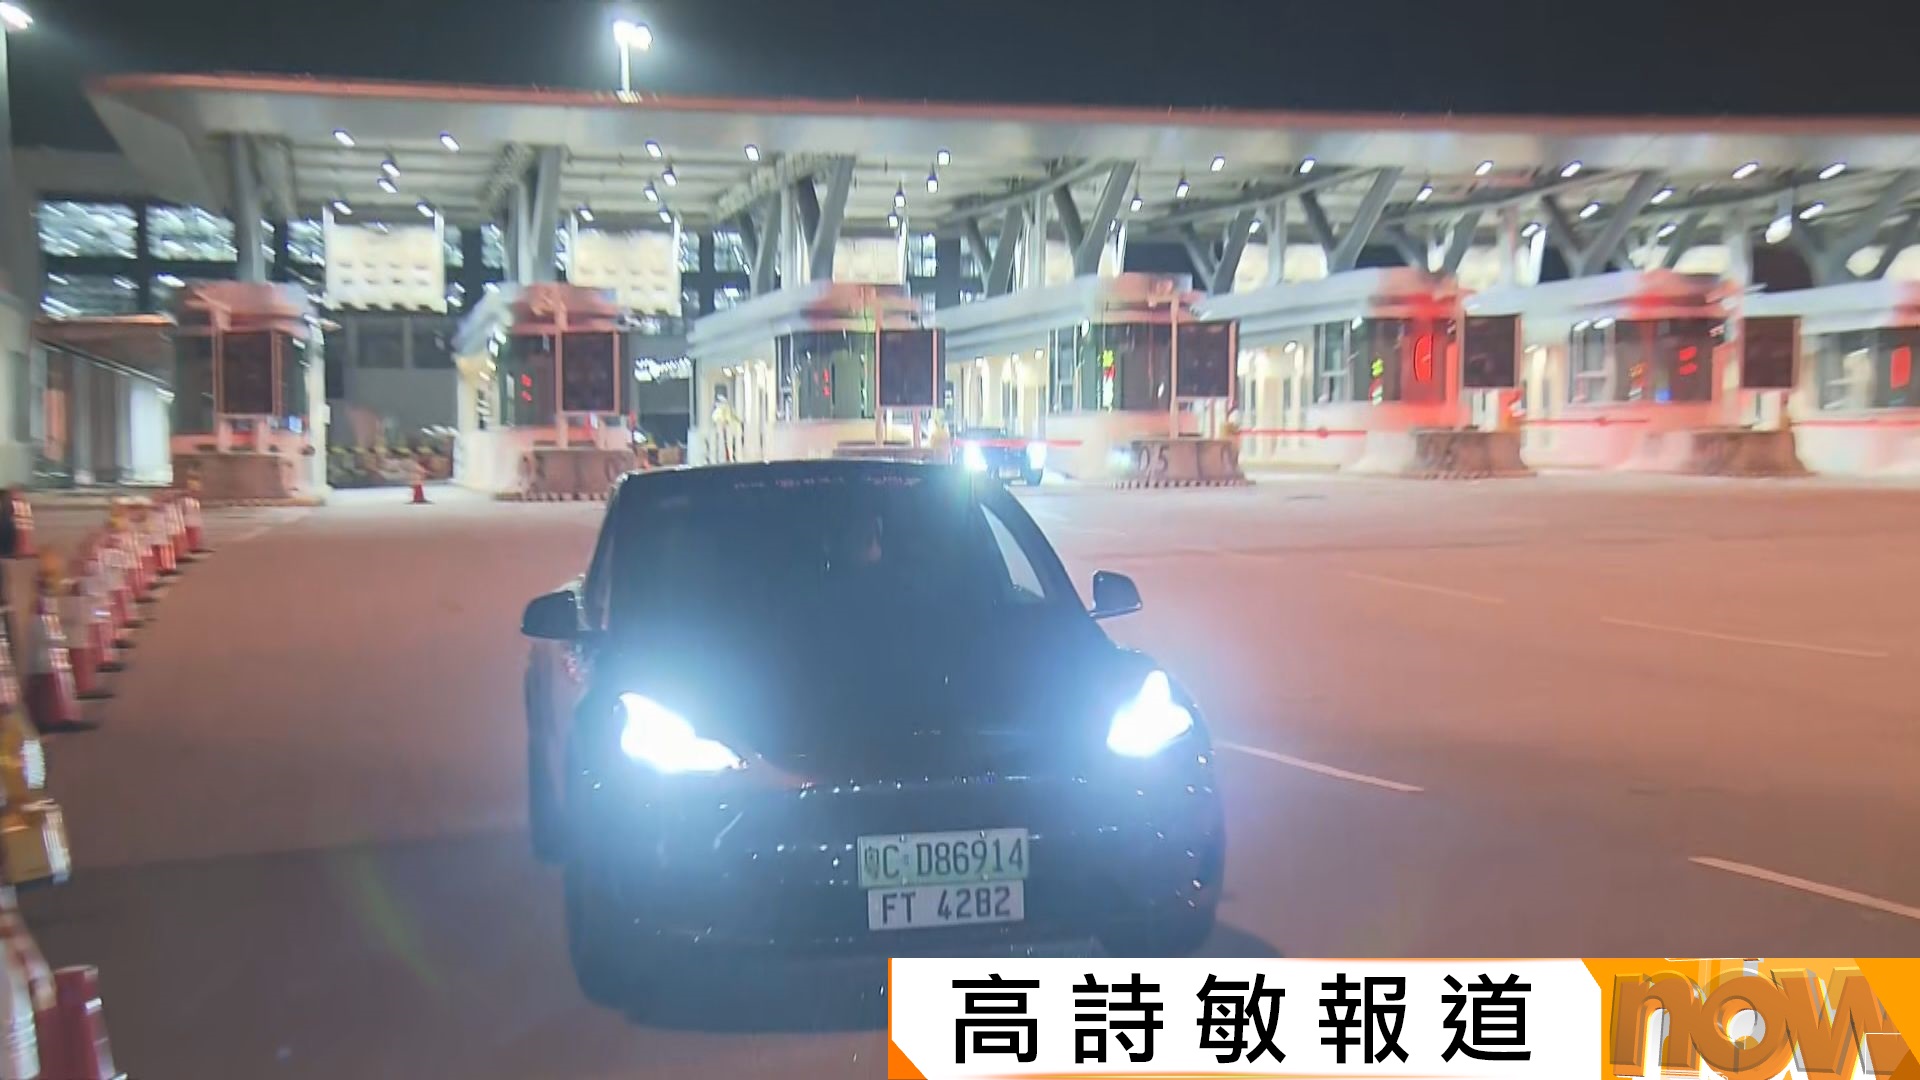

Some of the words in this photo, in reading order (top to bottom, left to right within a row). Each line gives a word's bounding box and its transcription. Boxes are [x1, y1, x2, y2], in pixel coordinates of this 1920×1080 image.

[916, 838, 1024, 877] D86914
[882, 892, 916, 924] FT
[937, 886, 1011, 920] 4282
